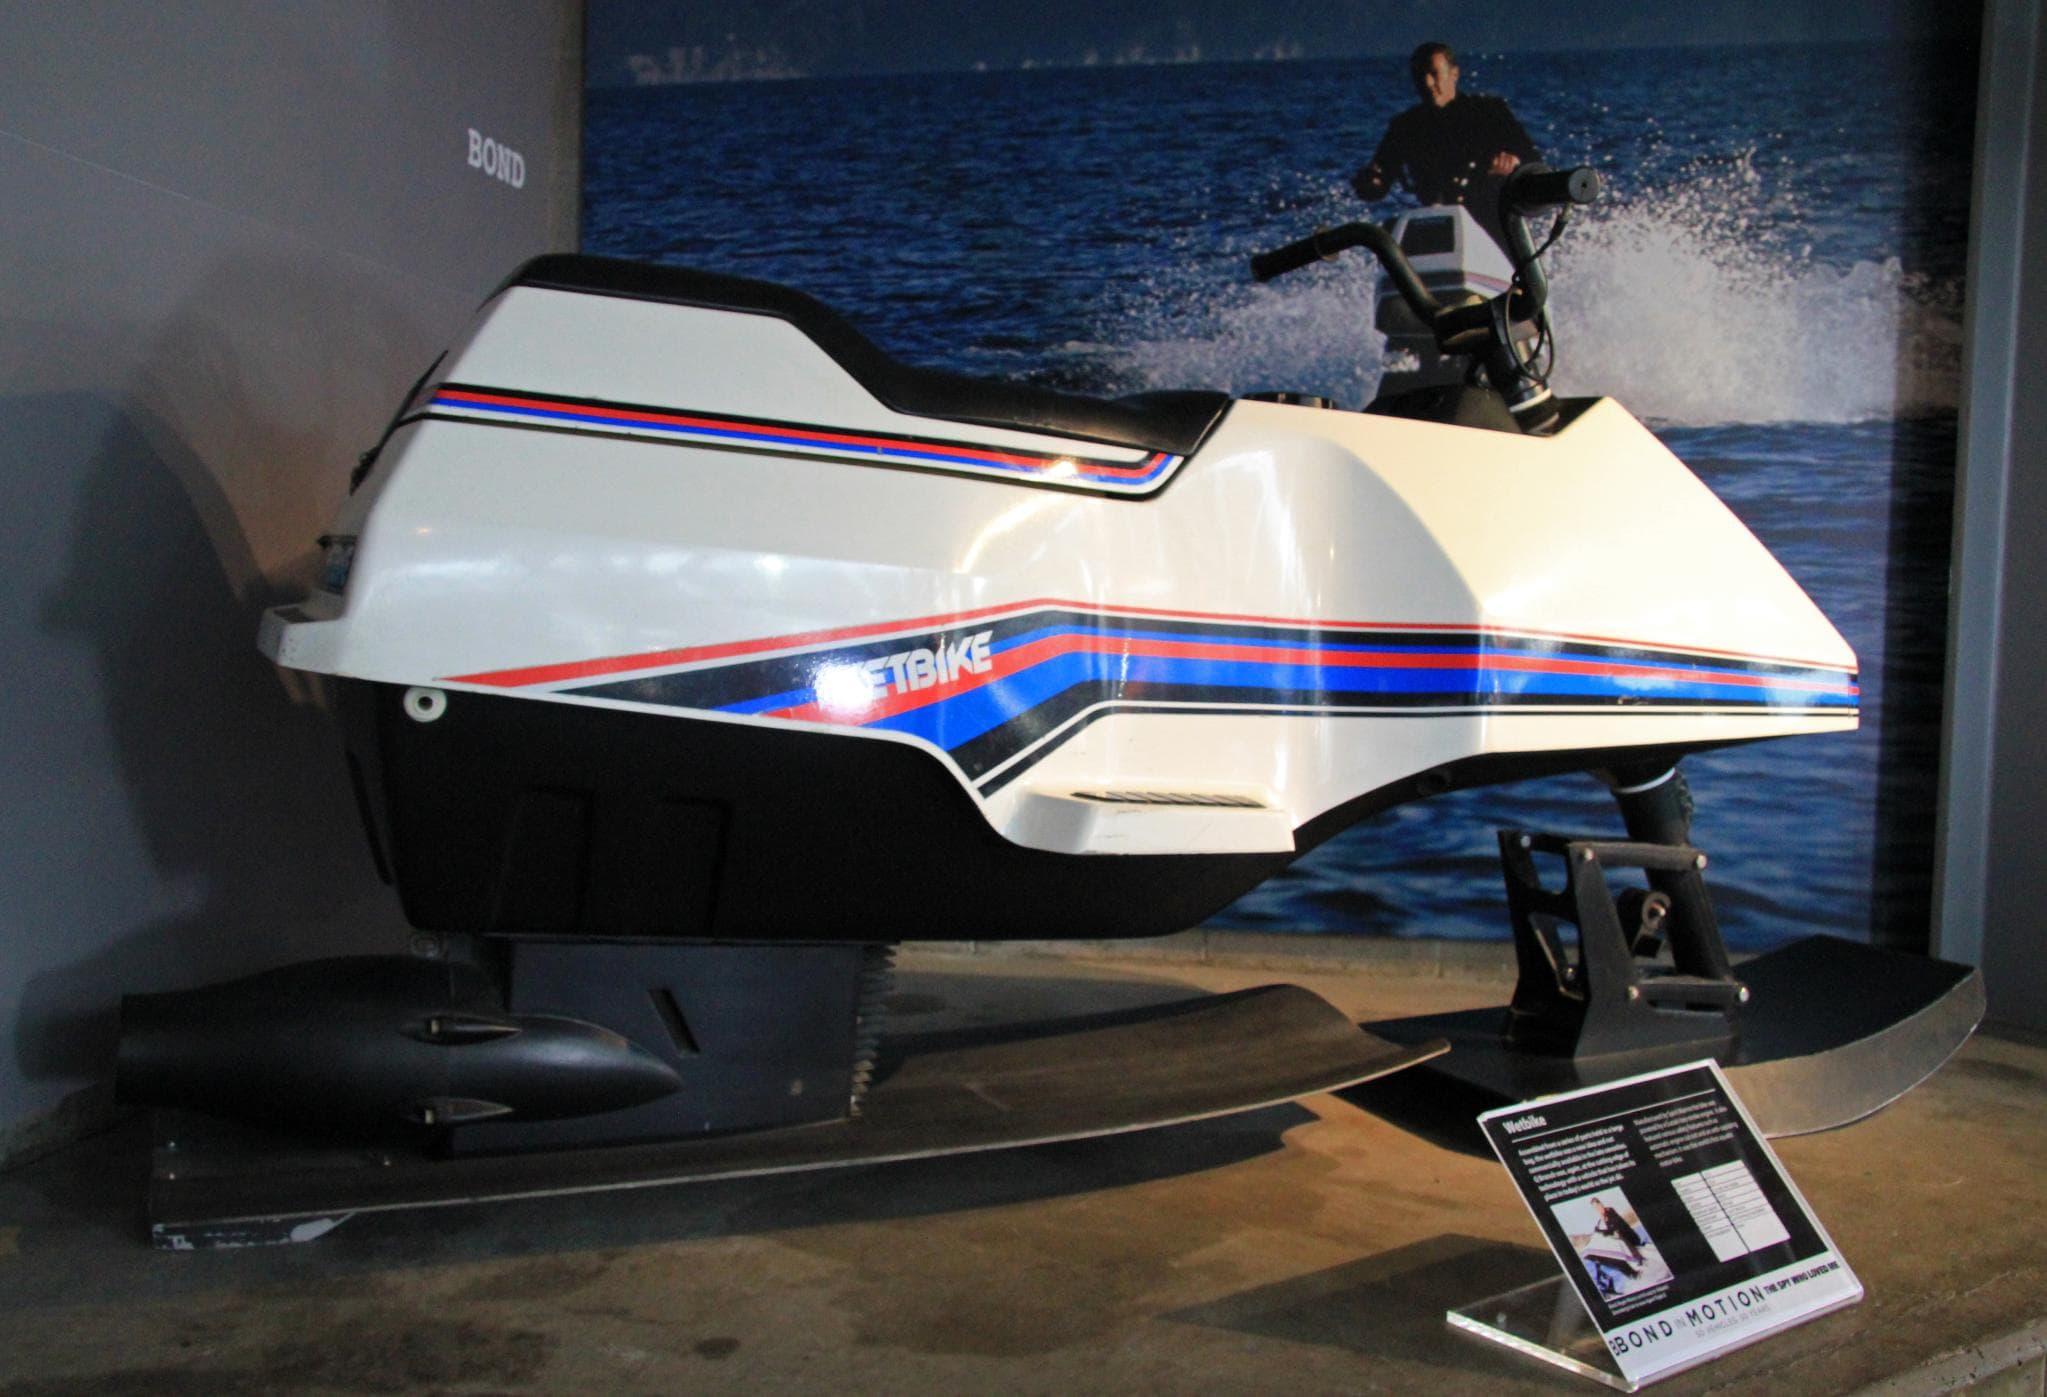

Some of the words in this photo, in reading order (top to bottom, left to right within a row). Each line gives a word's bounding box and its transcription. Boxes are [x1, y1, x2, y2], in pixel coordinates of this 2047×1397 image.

[467, 127, 525, 189] BOND
[842, 630, 993, 700] ETBIKE
[1502, 1115, 1548, 1134] Wetbike
[1763, 1283, 1778, 1295] THE
[1776, 1278, 1791, 1290] SPY
[1791, 1272, 1809, 1284] WHO
[1807, 1264, 1829, 1279] LOVED
[1827, 1260, 1840, 1271] ME
[1613, 1320, 1672, 1353] BOND
[1685, 1285, 1765, 1327] MOTION
